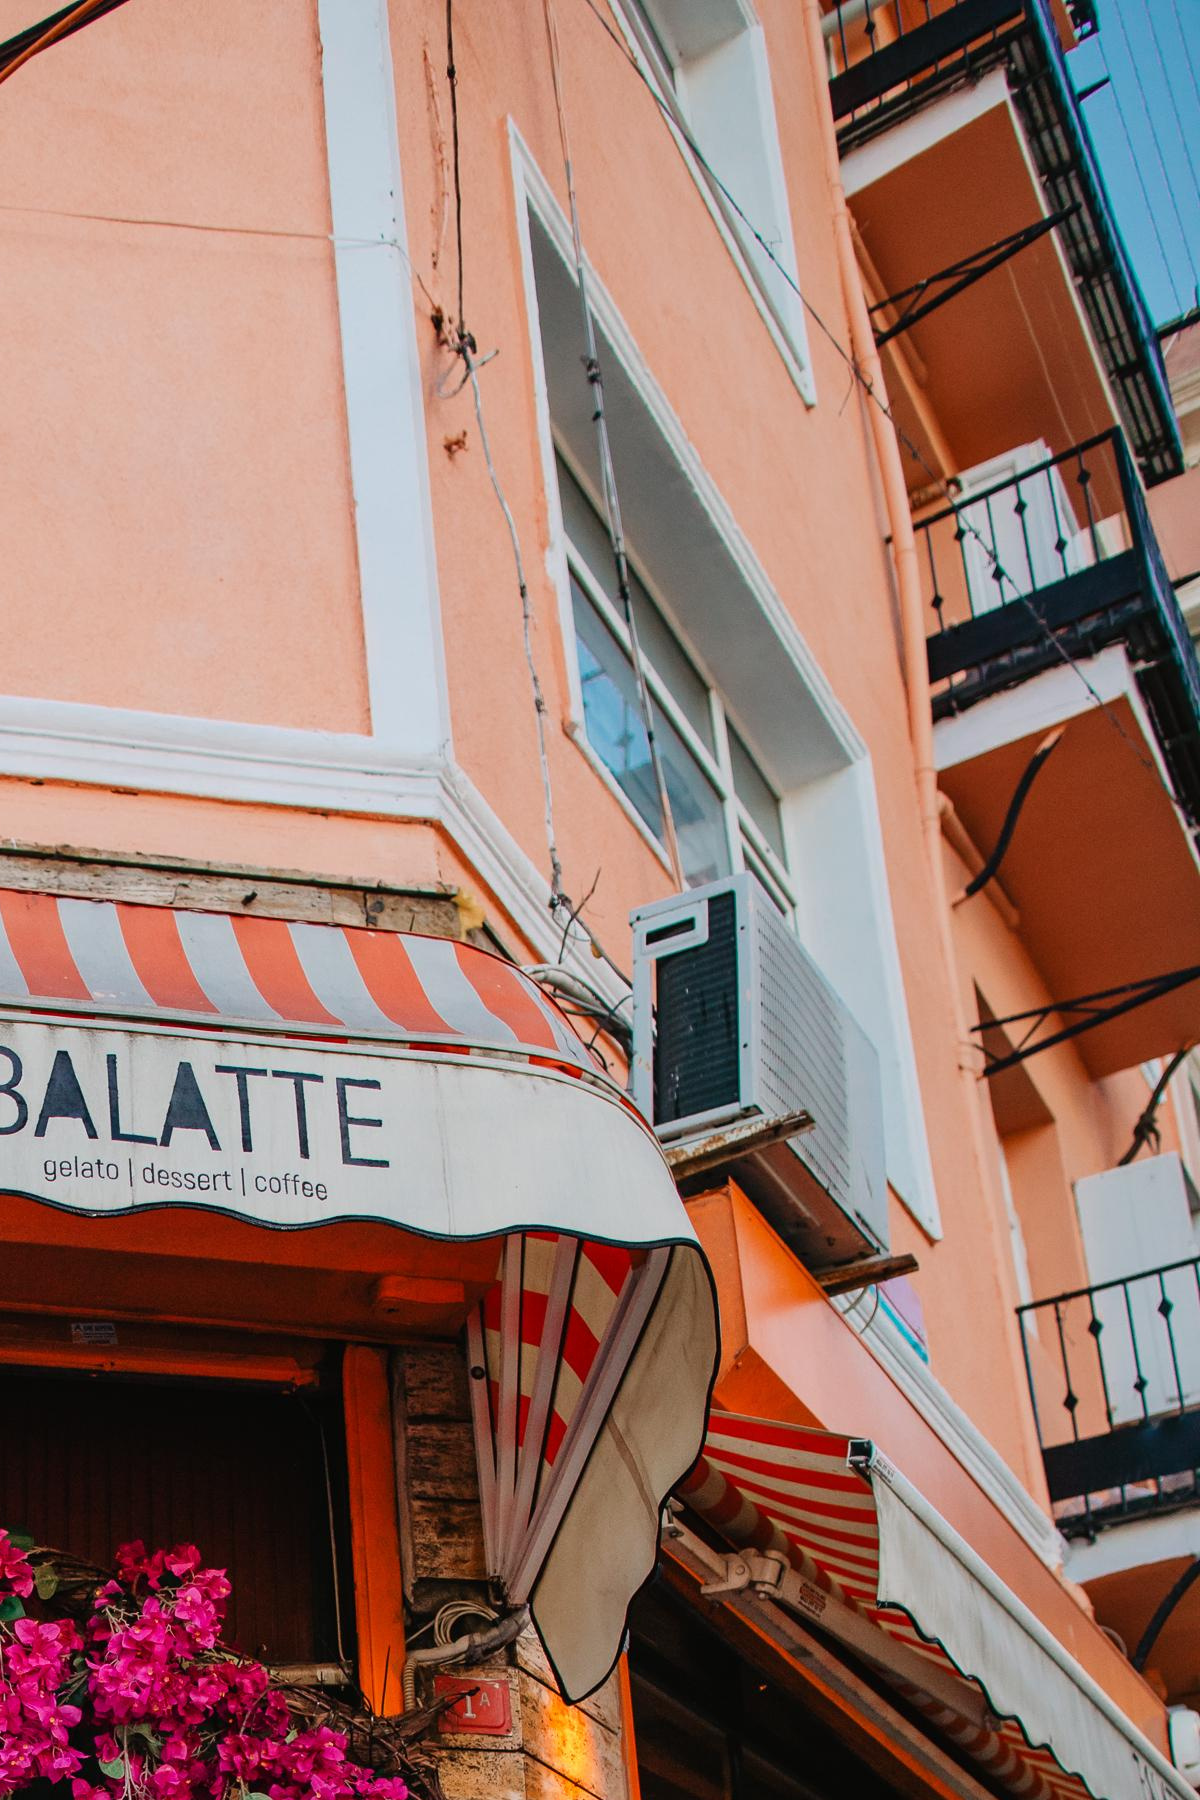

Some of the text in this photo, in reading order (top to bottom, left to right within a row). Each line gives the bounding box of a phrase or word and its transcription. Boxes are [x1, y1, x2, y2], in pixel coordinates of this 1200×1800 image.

[43, 1156, 119, 1182] gelato
[142, 1162, 233, 1191] dessert
[254, 1172, 328, 1201] coffee
